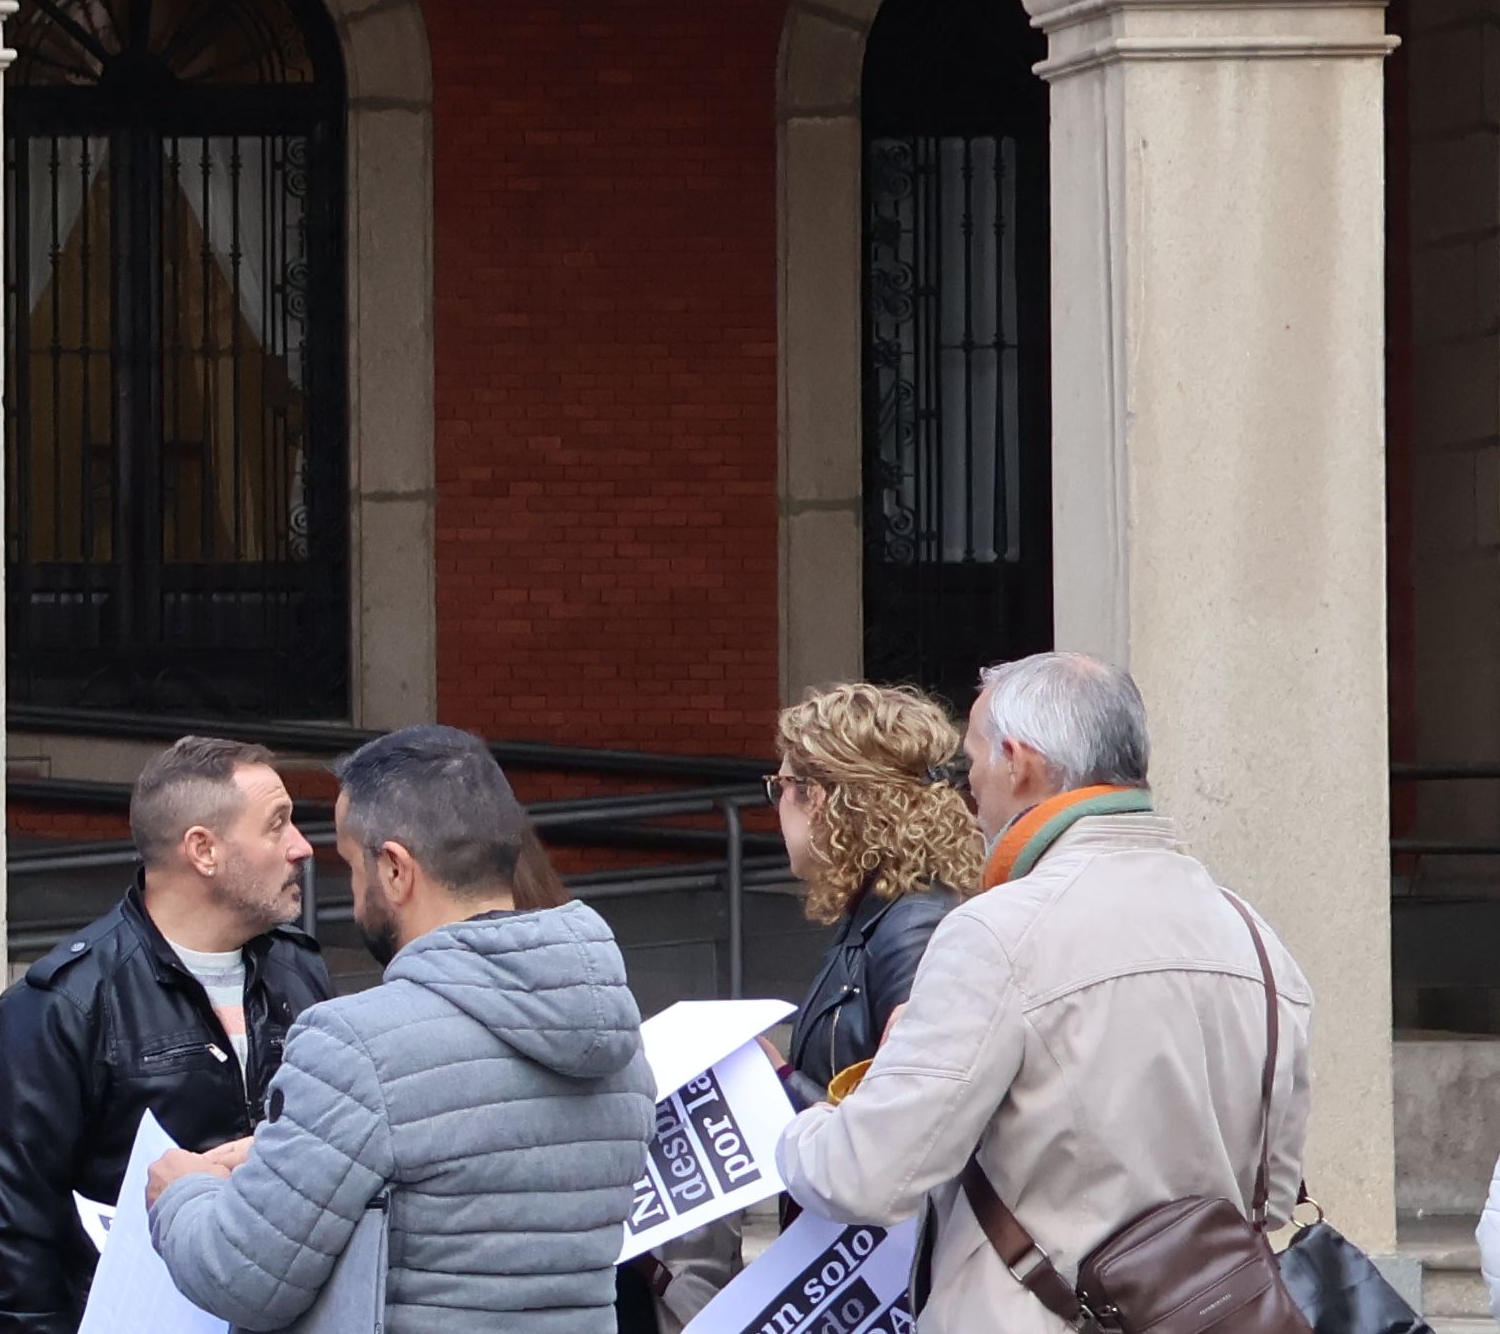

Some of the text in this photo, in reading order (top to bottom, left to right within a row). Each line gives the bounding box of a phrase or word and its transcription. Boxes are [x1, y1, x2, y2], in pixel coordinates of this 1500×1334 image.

[686, 1070, 759, 1184] por la
[803, 1228, 874, 1305] solo
